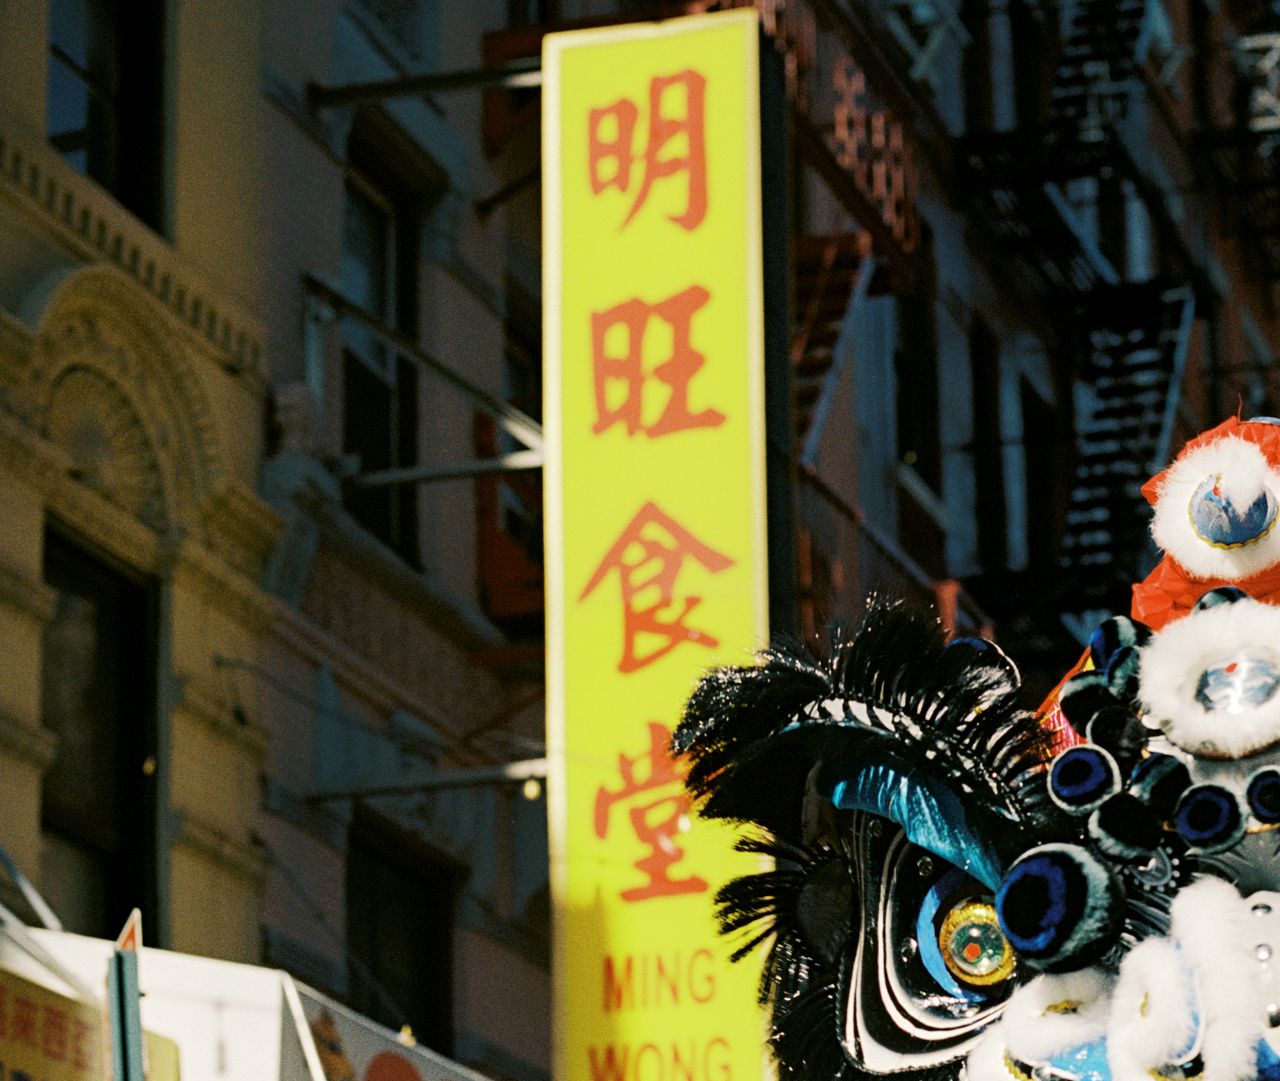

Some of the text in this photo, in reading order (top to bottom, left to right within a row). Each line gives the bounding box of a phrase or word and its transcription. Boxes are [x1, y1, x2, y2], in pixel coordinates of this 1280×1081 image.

[579, 69, 736, 902] 明旺食堂
[602, 948, 716, 1014] MING
